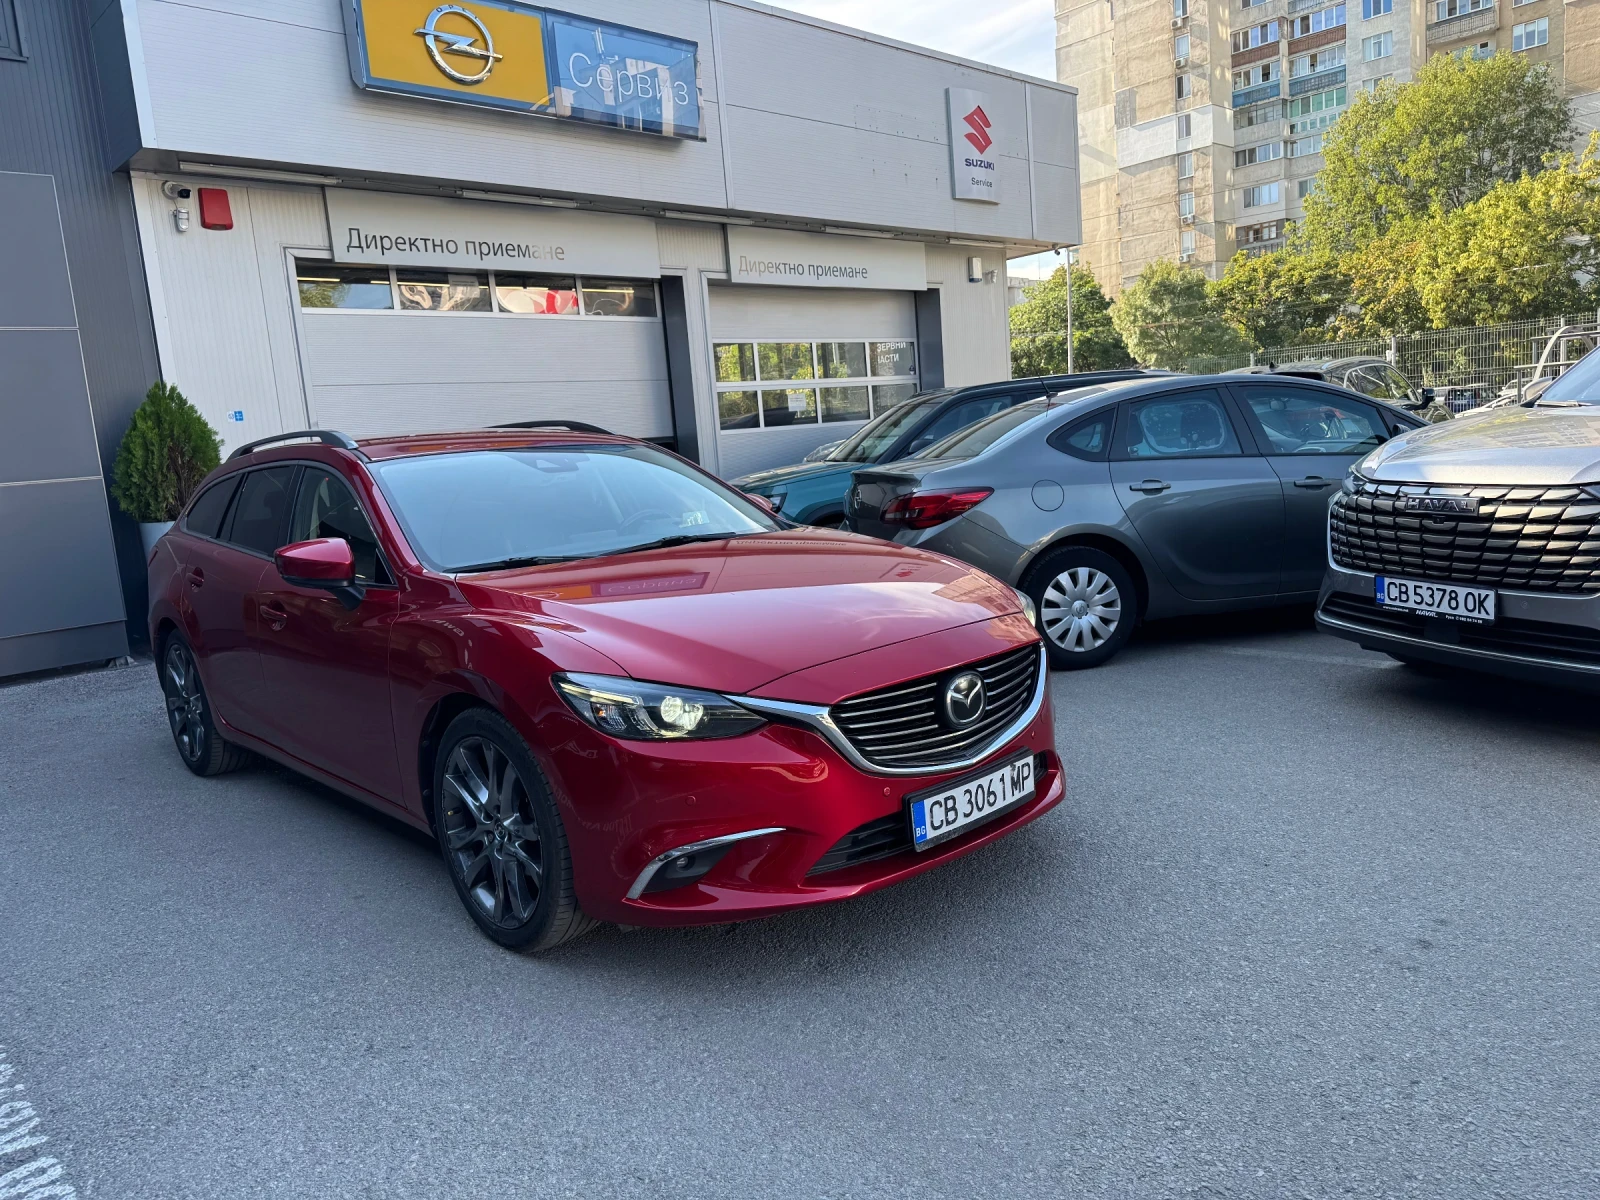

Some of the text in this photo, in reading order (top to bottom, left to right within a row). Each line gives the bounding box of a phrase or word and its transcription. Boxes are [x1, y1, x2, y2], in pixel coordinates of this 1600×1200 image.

[568, 52, 690, 106] Сервиз
[964, 158, 995, 171] SUZUKI
[971, 177, 993, 188] Service
[346, 228, 566, 261] Директно приемане
[738, 255, 868, 280] Директно приемане
[1407, 498, 1475, 513] HAVAL
[1376, 592, 1385, 600] BG
[1387, 581, 1491, 616] CB 5378 OK
[1415, 609, 1439, 618] HAVAL
[929, 762, 1031, 831] CB 3061 MP
[916, 825, 926, 838] BG
